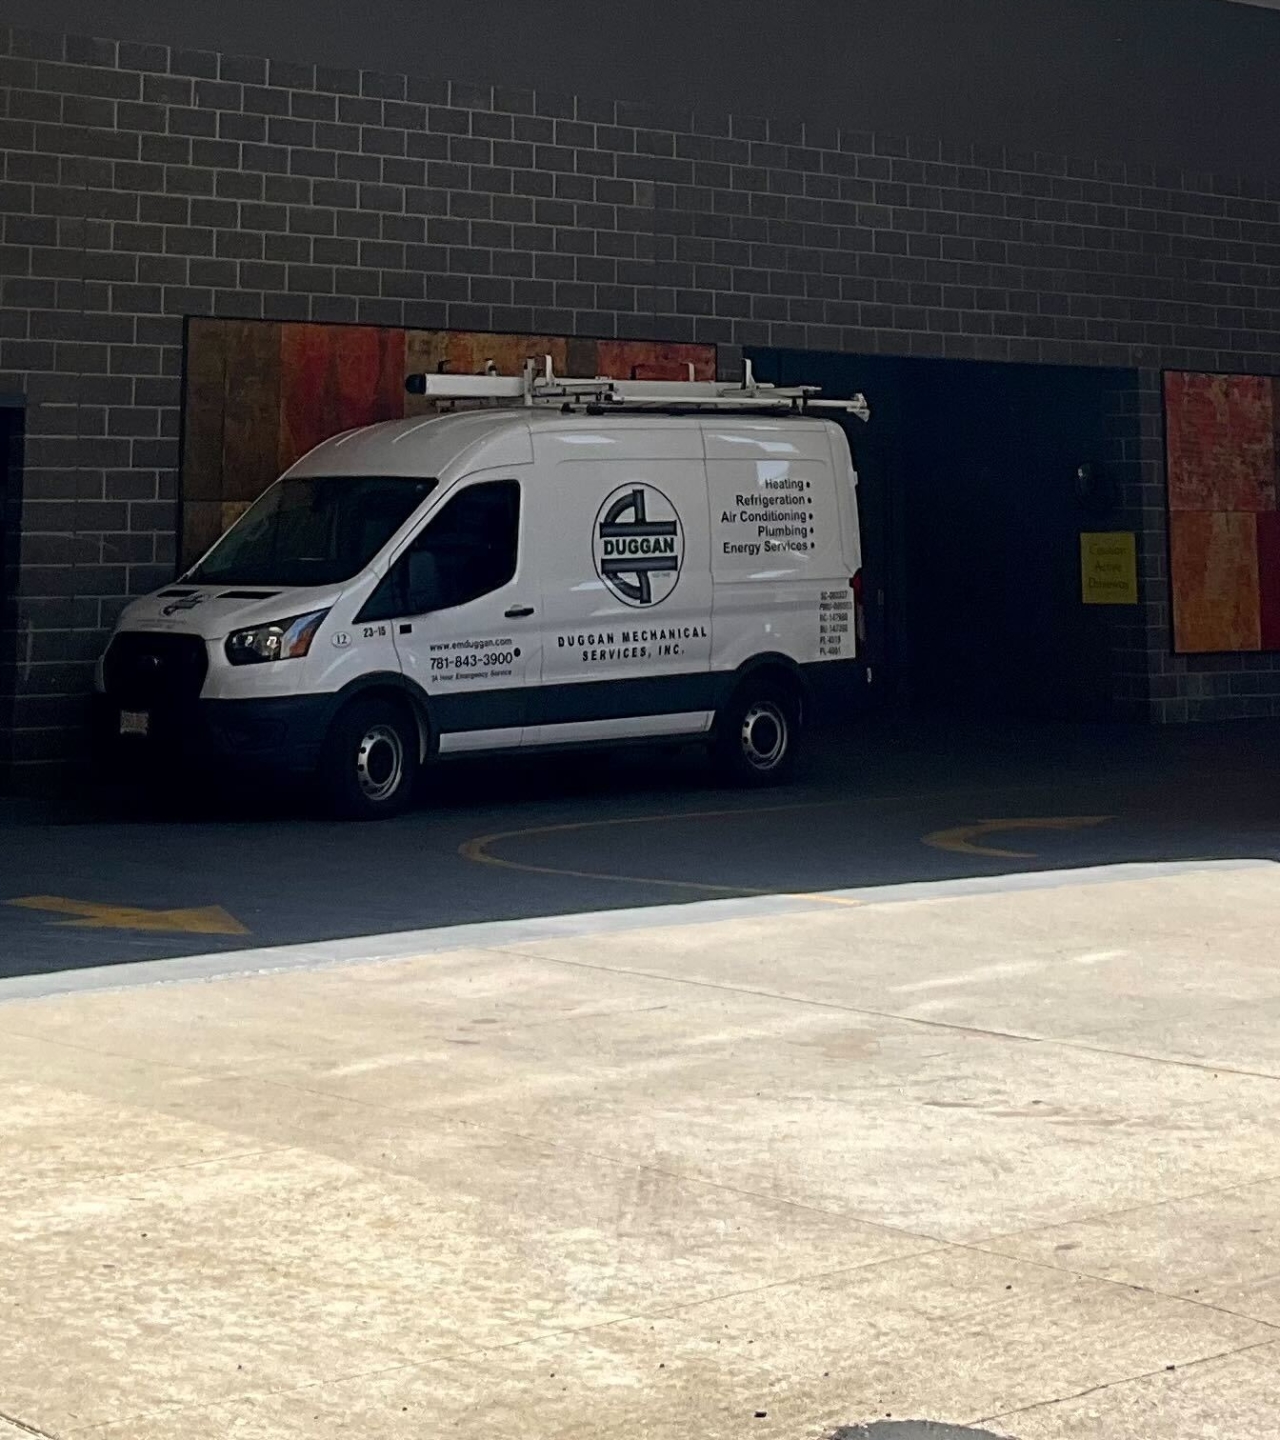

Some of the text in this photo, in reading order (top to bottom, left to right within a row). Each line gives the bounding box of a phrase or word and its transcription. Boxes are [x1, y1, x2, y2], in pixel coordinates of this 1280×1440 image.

[765, 478, 804, 492] Heating
[735, 494, 806, 509] Refrigeration
[721, 510, 807, 523] Air Conditioning
[758, 525, 808, 539] Plumbing
[603, 537, 675, 556] DUGGAN
[723, 540, 808, 556] Energy Services
[336, 634, 347, 645] 12
[558, 626, 707, 647] DUGGAN MECHANICAL
[429, 637, 512, 652] www.emduggan.com
[582, 644, 685, 661] SERVICES, INC.
[430, 652, 513, 670] 781-843-3900
[455, 671, 489, 681] Emergency
[490, 669, 512, 678] Service
